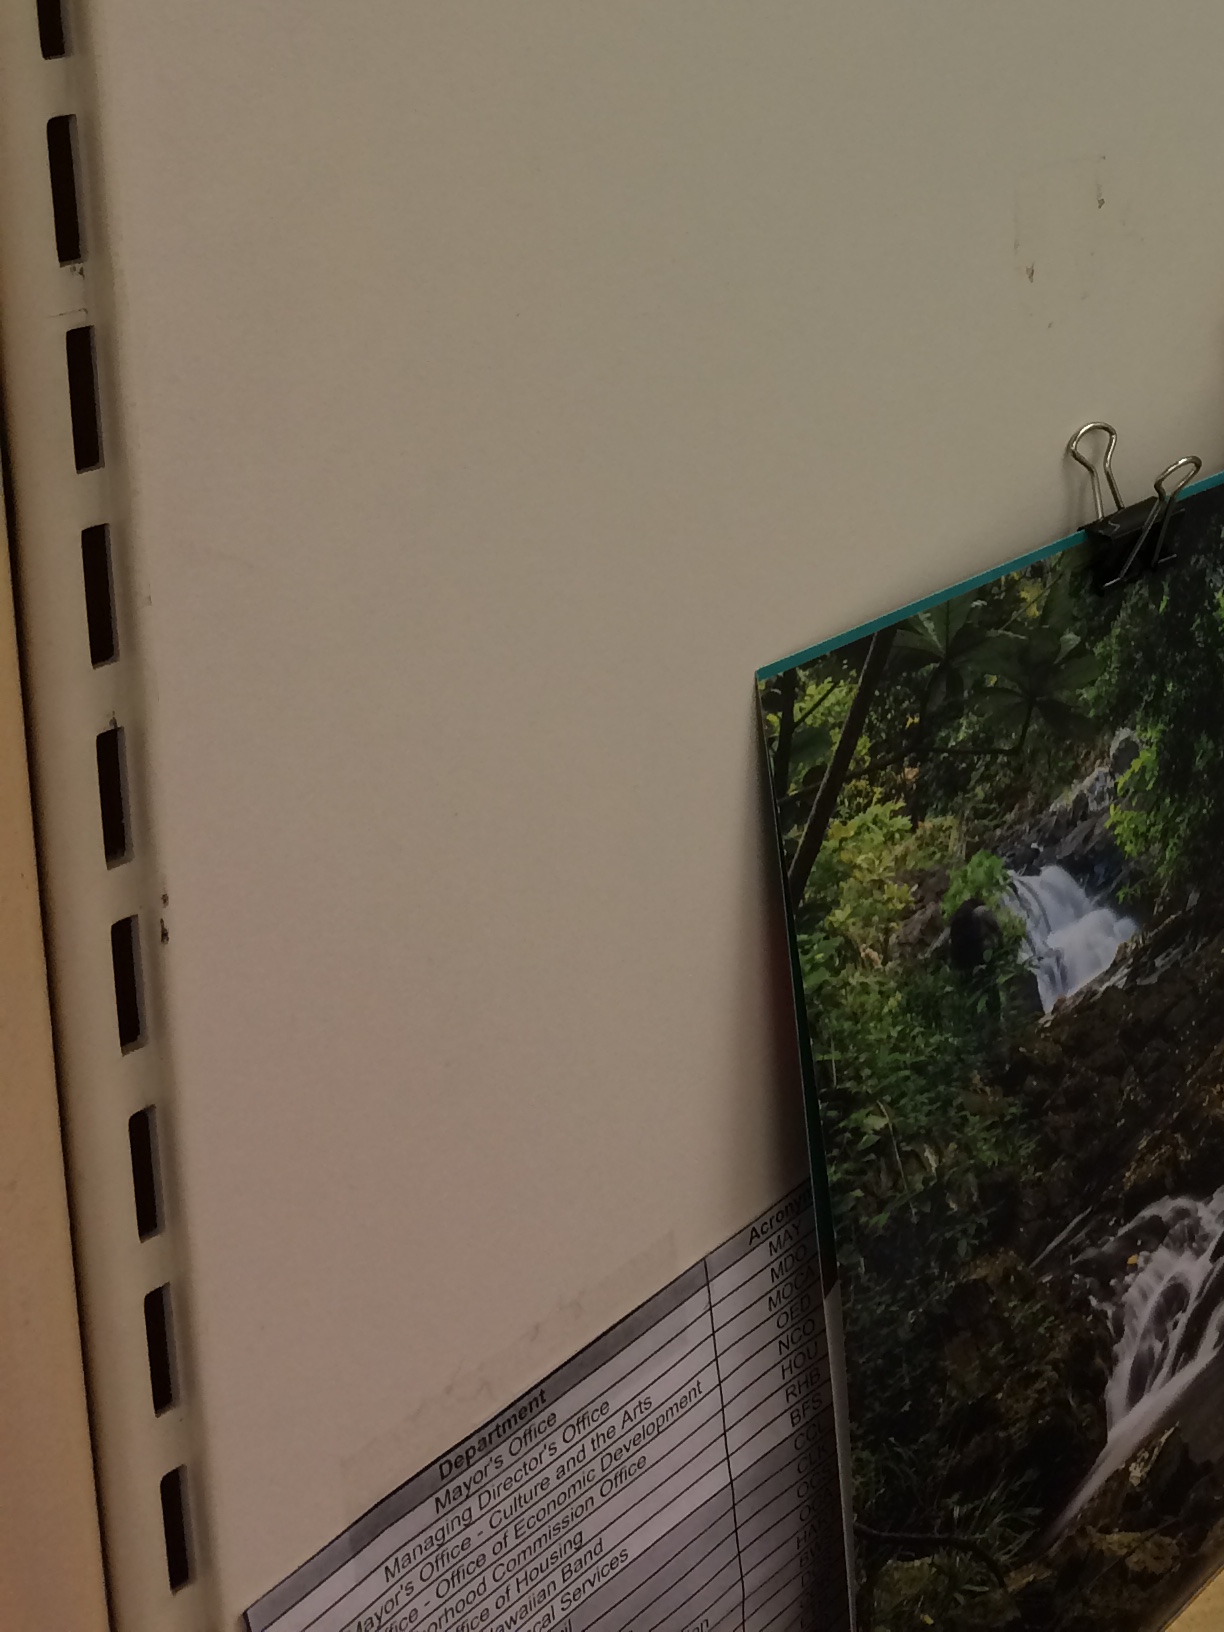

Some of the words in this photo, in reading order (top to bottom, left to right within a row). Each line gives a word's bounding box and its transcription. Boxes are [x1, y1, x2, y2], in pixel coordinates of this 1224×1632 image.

[768, 1223, 801, 1257] MAY
[770, 1243, 807, 1285] MDO
[776, 1291, 813, 1330] OED
[778, 1318, 816, 1356] NCO
[781, 1341, 821, 1381] HOU
[785, 1371, 822, 1404] RHB
[439, 1388, 546, 1481] Department
[788, 1393, 823, 1429] BFS
[384, 1506, 473, 1583] Managing
[478, 1442, 558, 1511] Director's
[562, 1401, 610, 1444] Office
[419, 1537, 471, 1583] Office
[488, 1476, 551, 1530] Culture
[555, 1443, 587, 1480] and
[590, 1425, 616, 1452] the
[621, 1396, 653, 1430] Arts
[434, 1455, 504, 1514] Mayor's
[508, 1412, 557, 1457] Office
[435, 1553, 487, 1599] Office
[492, 1530, 509, 1556] of
[513, 1469, 596, 1540] Economic
[596, 1381, 705, 1472] Development
[492, 1496, 598, 1583] Commission
[599, 1455, 647, 1498] Office
[495, 1584, 511, 1610] of
[515, 1531, 583, 1592] Housing
[496, 1580, 560, 1632] awaiian
[561, 1537, 604, 1584] Band
[560, 1547, 630, 1613] Services
